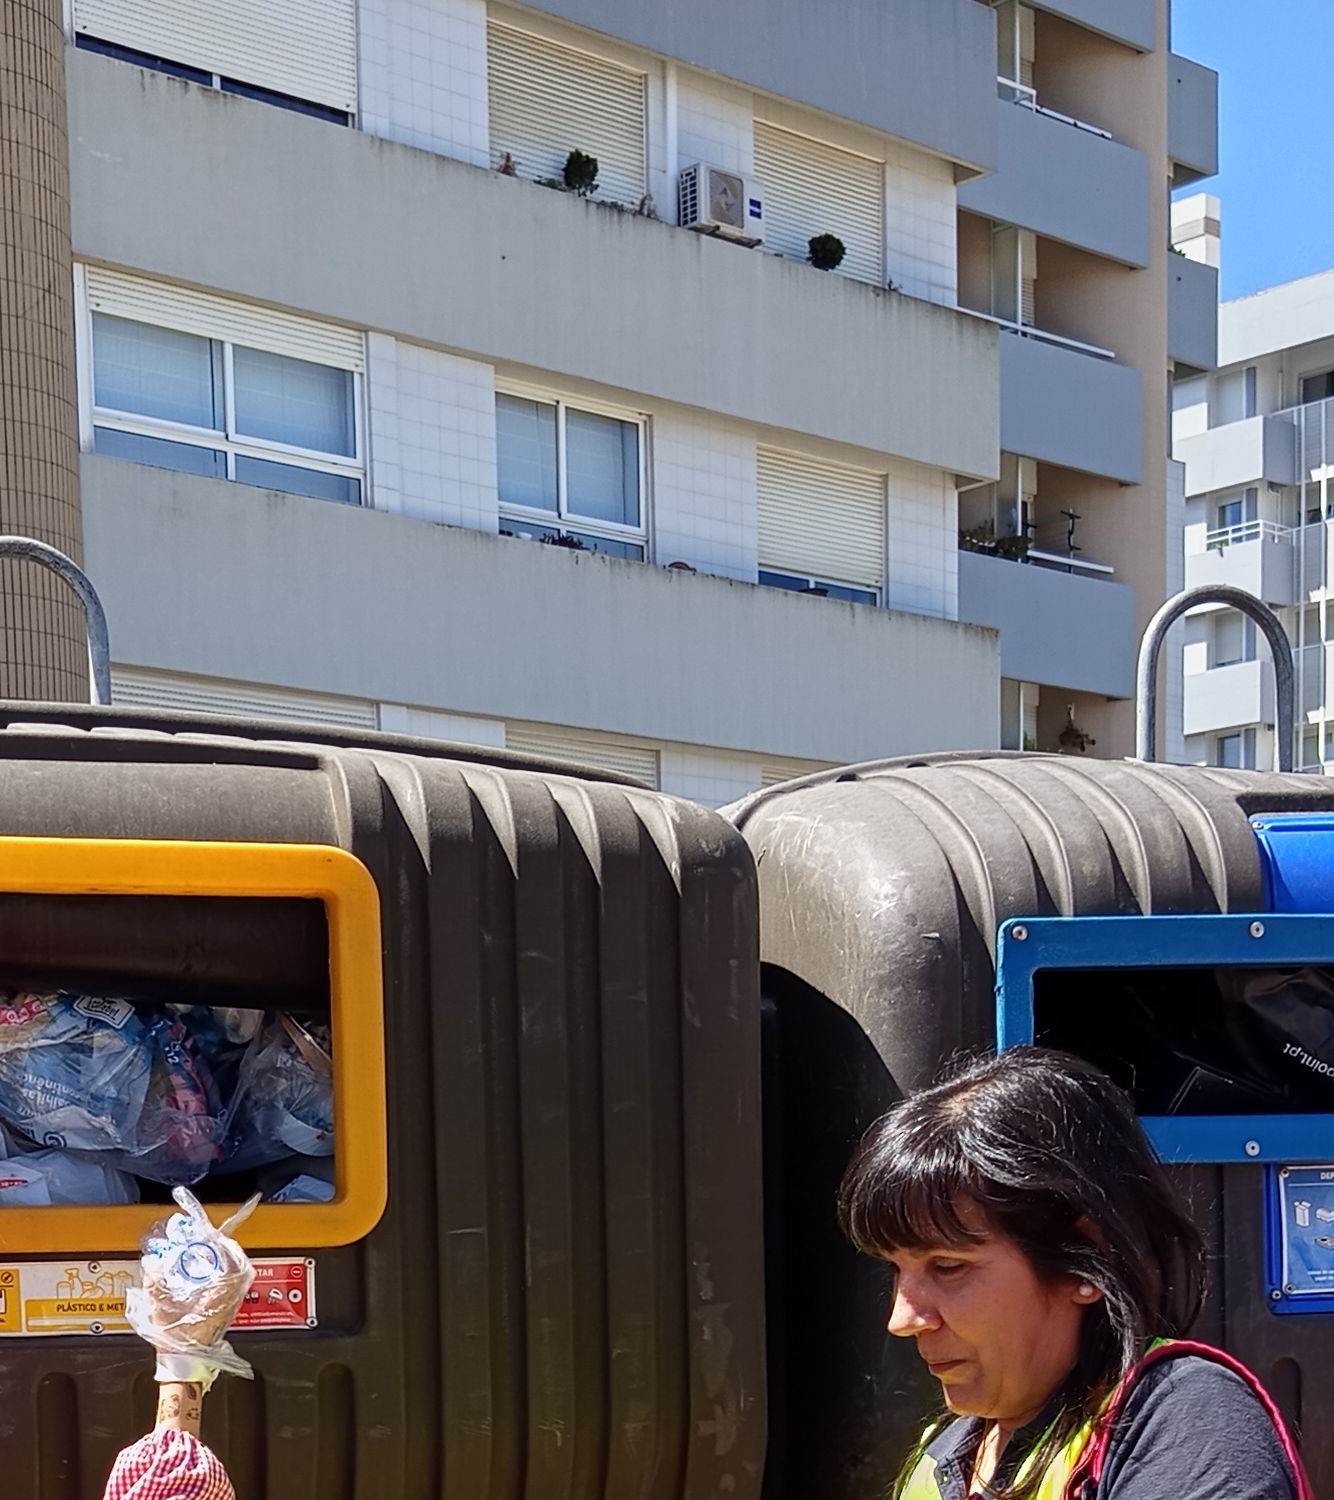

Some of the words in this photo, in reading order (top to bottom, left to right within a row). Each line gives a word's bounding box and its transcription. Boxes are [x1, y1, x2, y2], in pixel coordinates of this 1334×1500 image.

[56, 1301, 98, 1312] PLÁSTICO
[99, 1303, 104, 1311] E
[106, 1302, 126, 1311] MET
